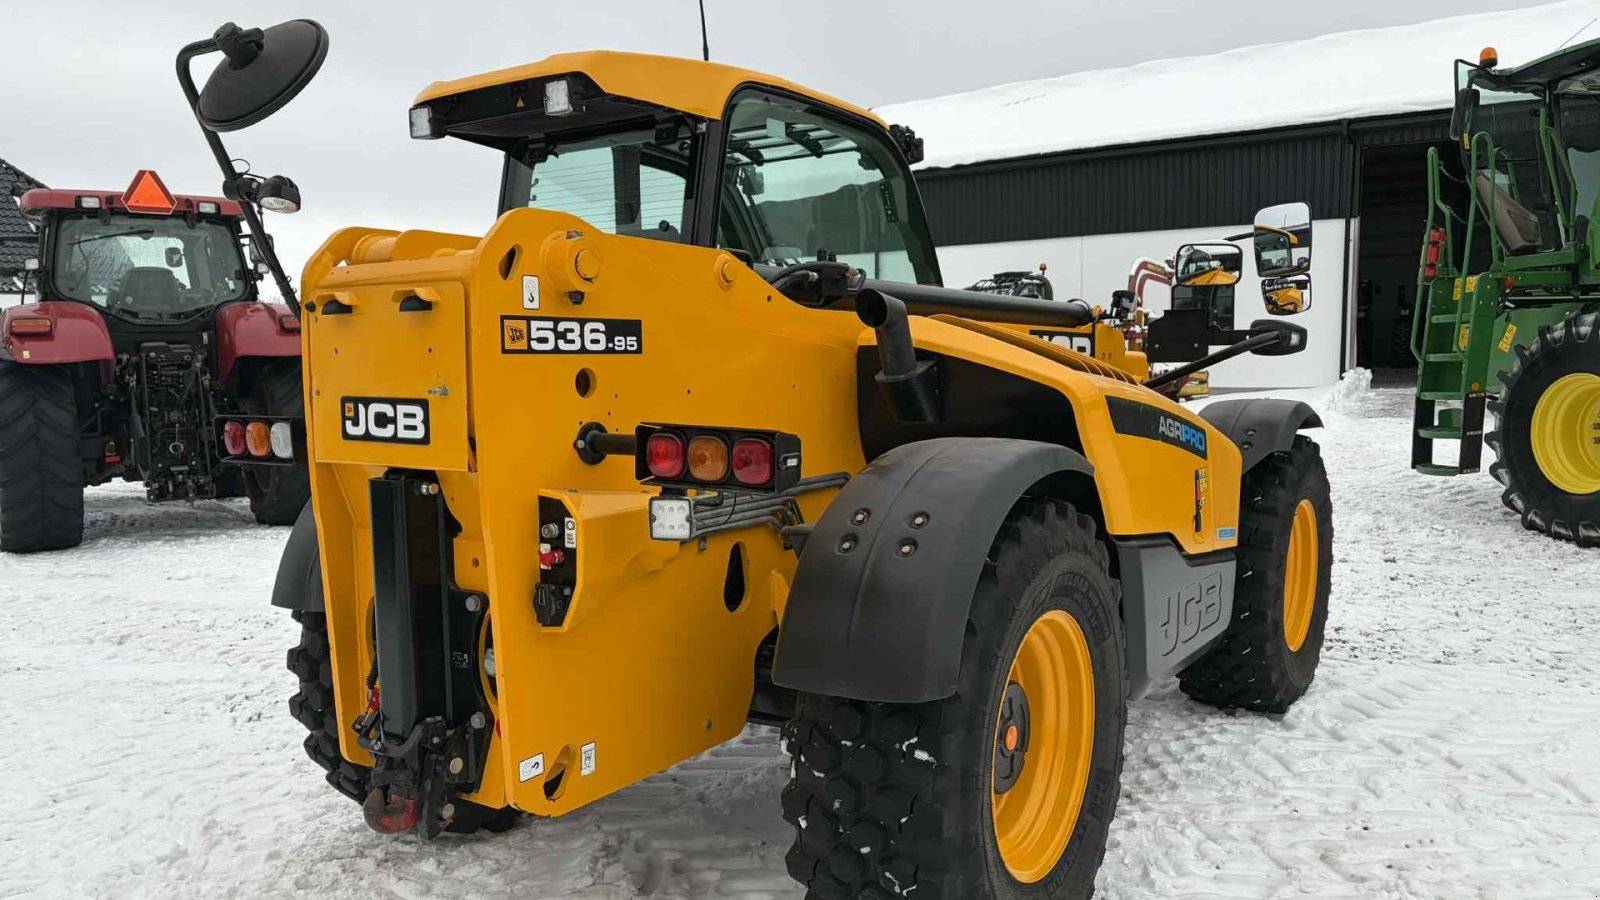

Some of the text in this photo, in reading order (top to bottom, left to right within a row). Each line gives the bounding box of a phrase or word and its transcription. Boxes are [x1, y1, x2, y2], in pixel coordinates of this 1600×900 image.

[530, 320, 638, 351] 536-95
[345, 402, 425, 439] JCB
[1158, 415, 1206, 452] AGRIPRO
[1159, 570, 1223, 657] JCB
